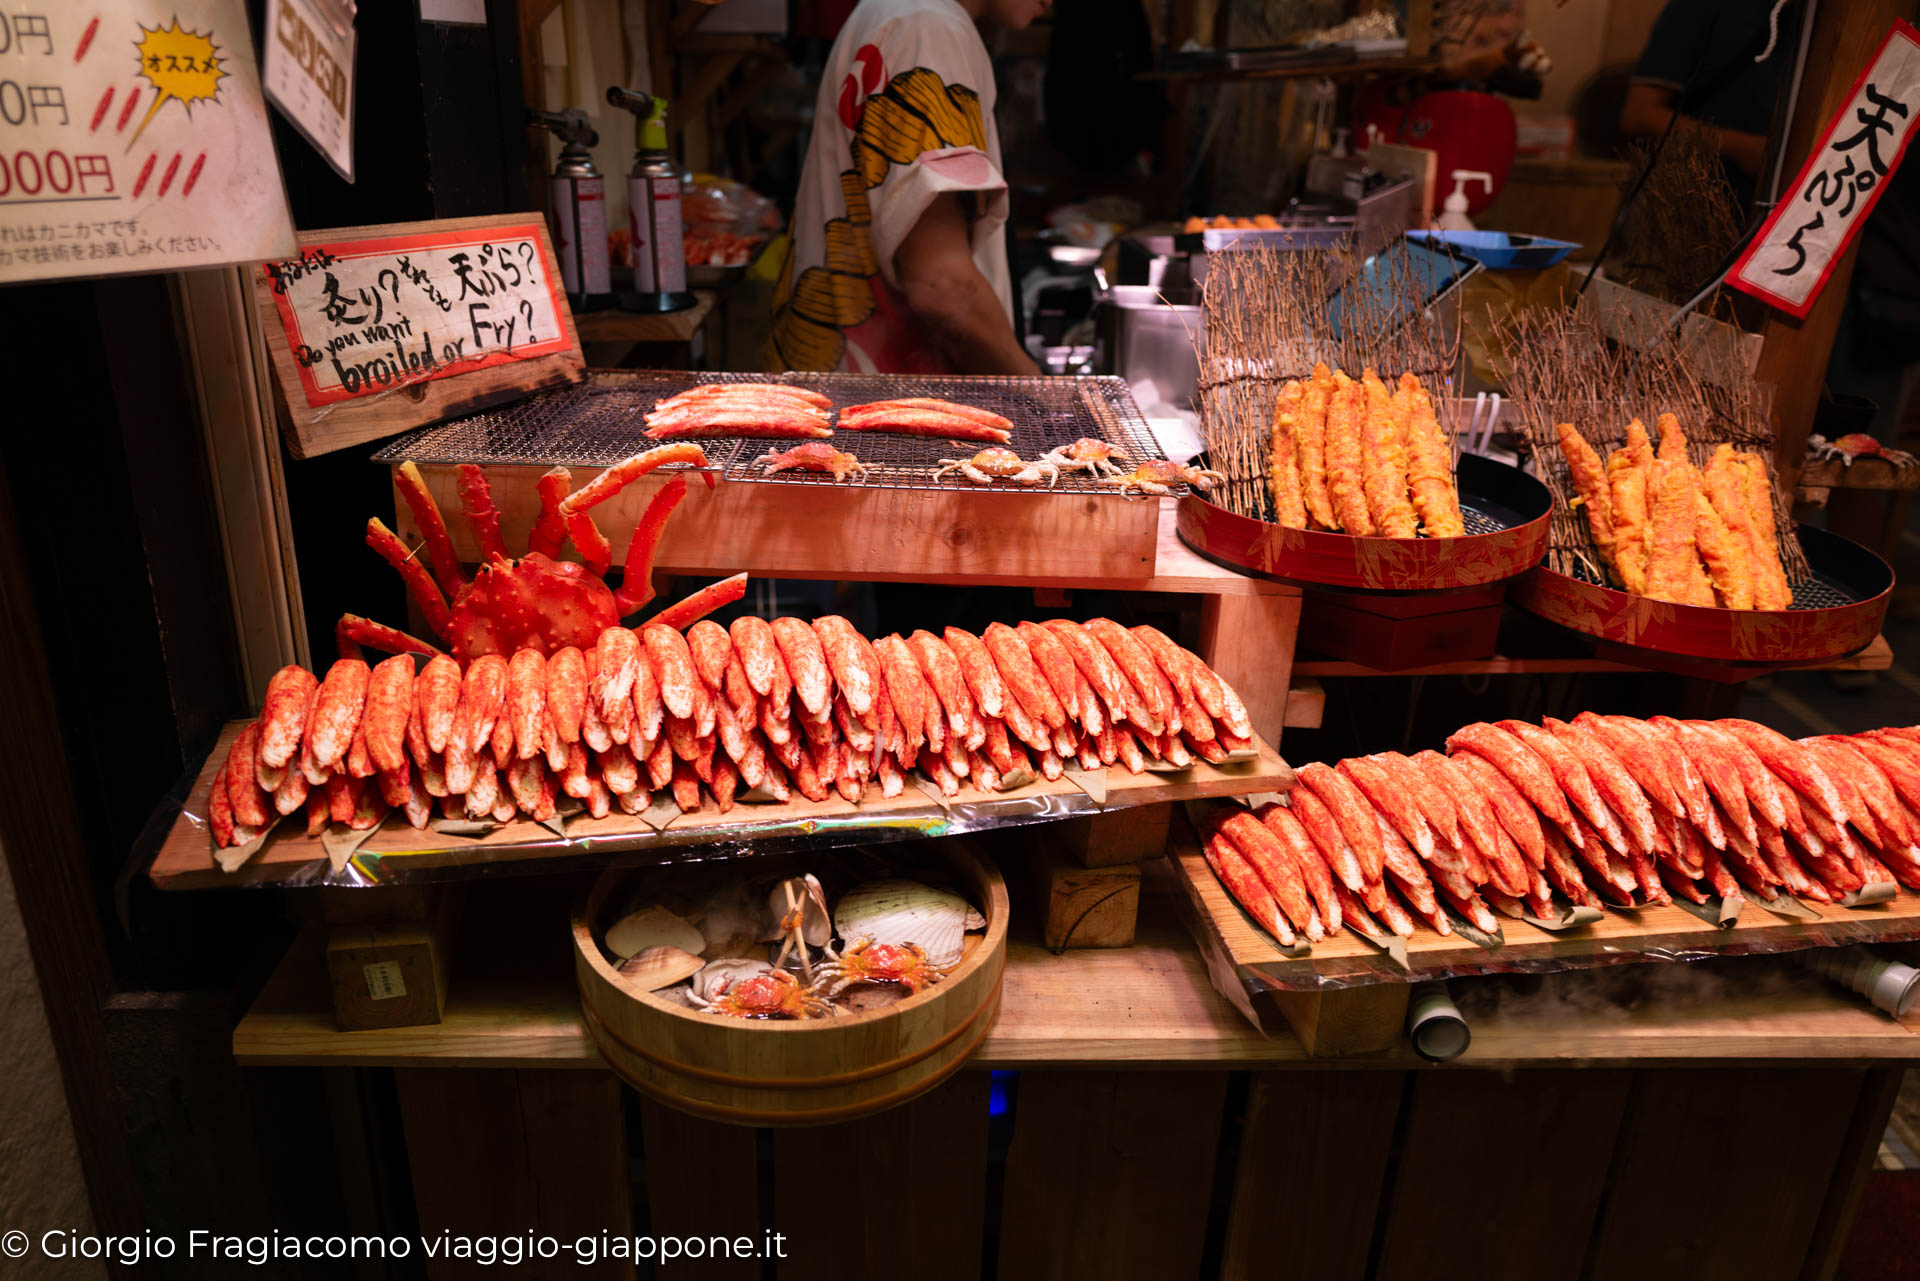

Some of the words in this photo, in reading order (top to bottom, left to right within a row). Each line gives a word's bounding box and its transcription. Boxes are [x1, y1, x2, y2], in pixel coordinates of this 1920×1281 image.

[147, 54, 215, 74] オススメ
[1772, 83, 1908, 276] 天ぷら
[448, 242, 536, 301] 天ぷら?
[296, 344, 323, 368] Do
[325, 331, 361, 359] you
[361, 316, 413, 344] want
[331, 332, 444, 393] broiled
[443, 337, 464, 364] or
[469, 300, 537, 353] Fry?
